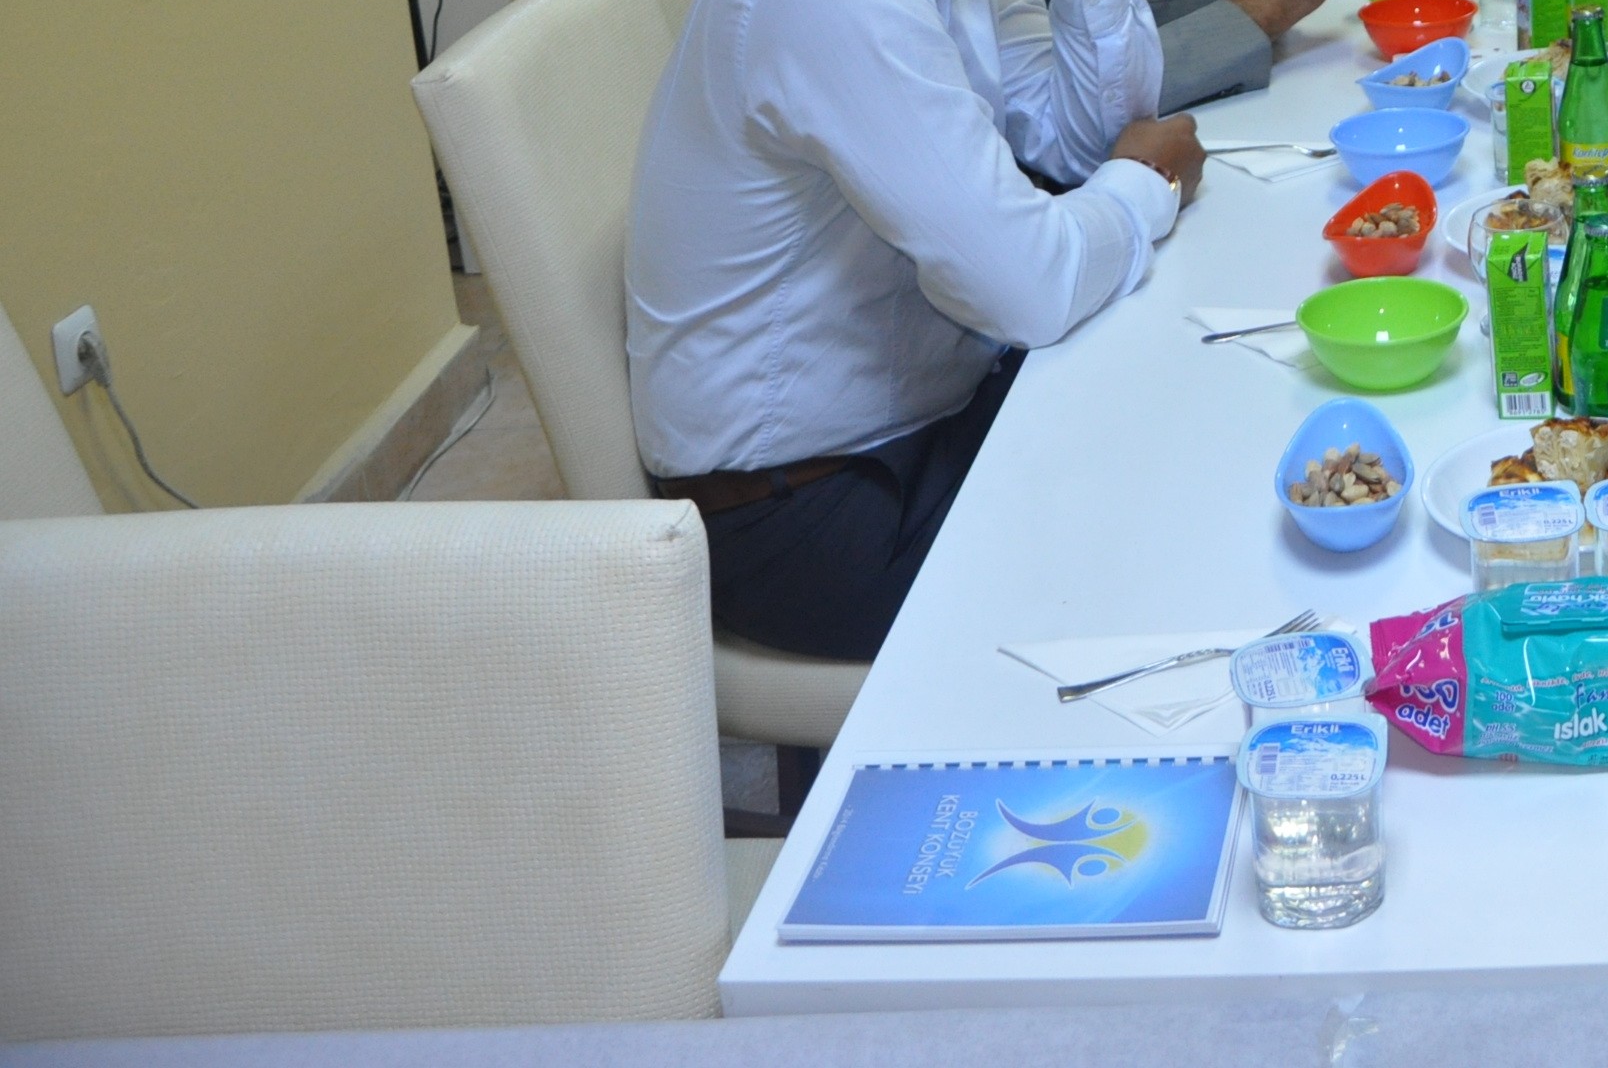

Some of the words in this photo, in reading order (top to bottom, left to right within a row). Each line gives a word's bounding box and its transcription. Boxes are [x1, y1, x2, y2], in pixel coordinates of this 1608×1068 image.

[1499, 487, 1541, 497] Erikli
[1331, 647, 1355, 673] Erikli
[1492, 700, 1517, 712] adet
[1495, 690, 1516, 702] 100
[1290, 724, 1340, 734] Erikli
[1396, 701, 1451, 740] adet
[1554, 706, 1608, 740] ıslak
[931, 794, 960, 830] KENT
[935, 810, 978, 878] BOZÜYÜK
[903, 833, 945, 894] KONSEYİ
